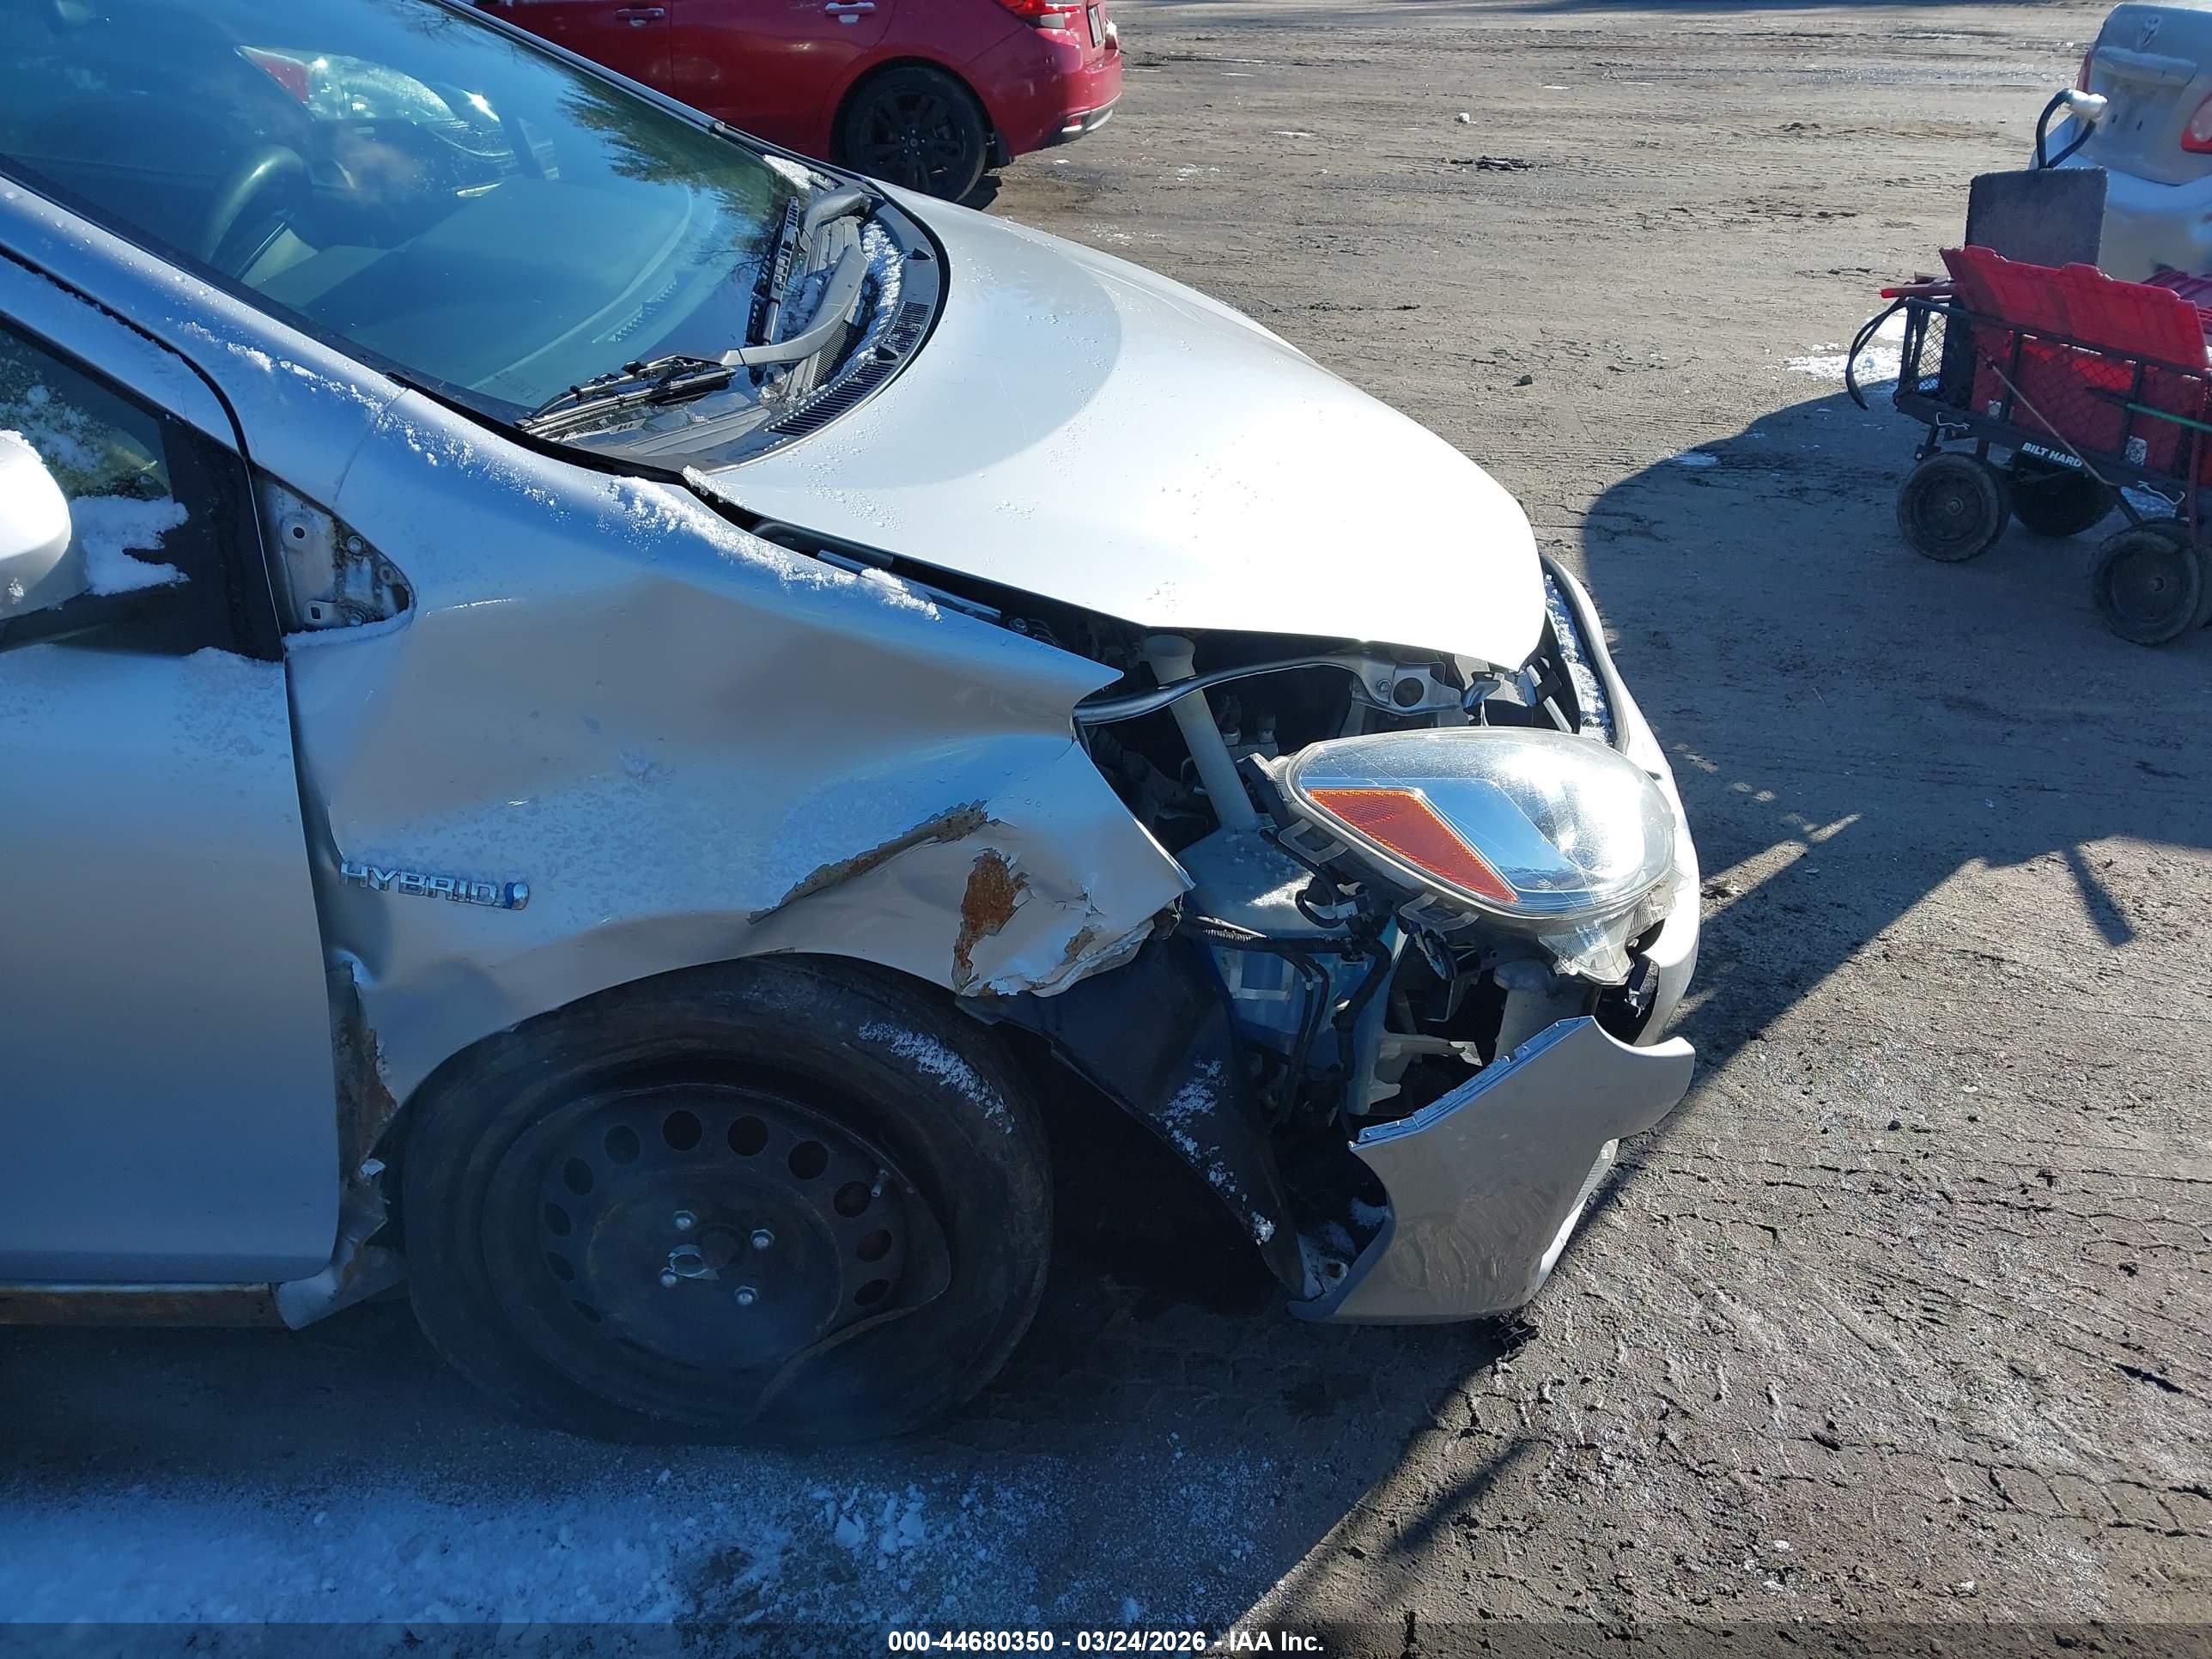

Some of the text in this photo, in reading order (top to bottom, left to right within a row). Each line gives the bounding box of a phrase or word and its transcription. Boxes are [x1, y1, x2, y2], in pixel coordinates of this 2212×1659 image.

[2021, 442, 2082, 467] BILT HARD
[340, 863, 500, 906] HYBRID
